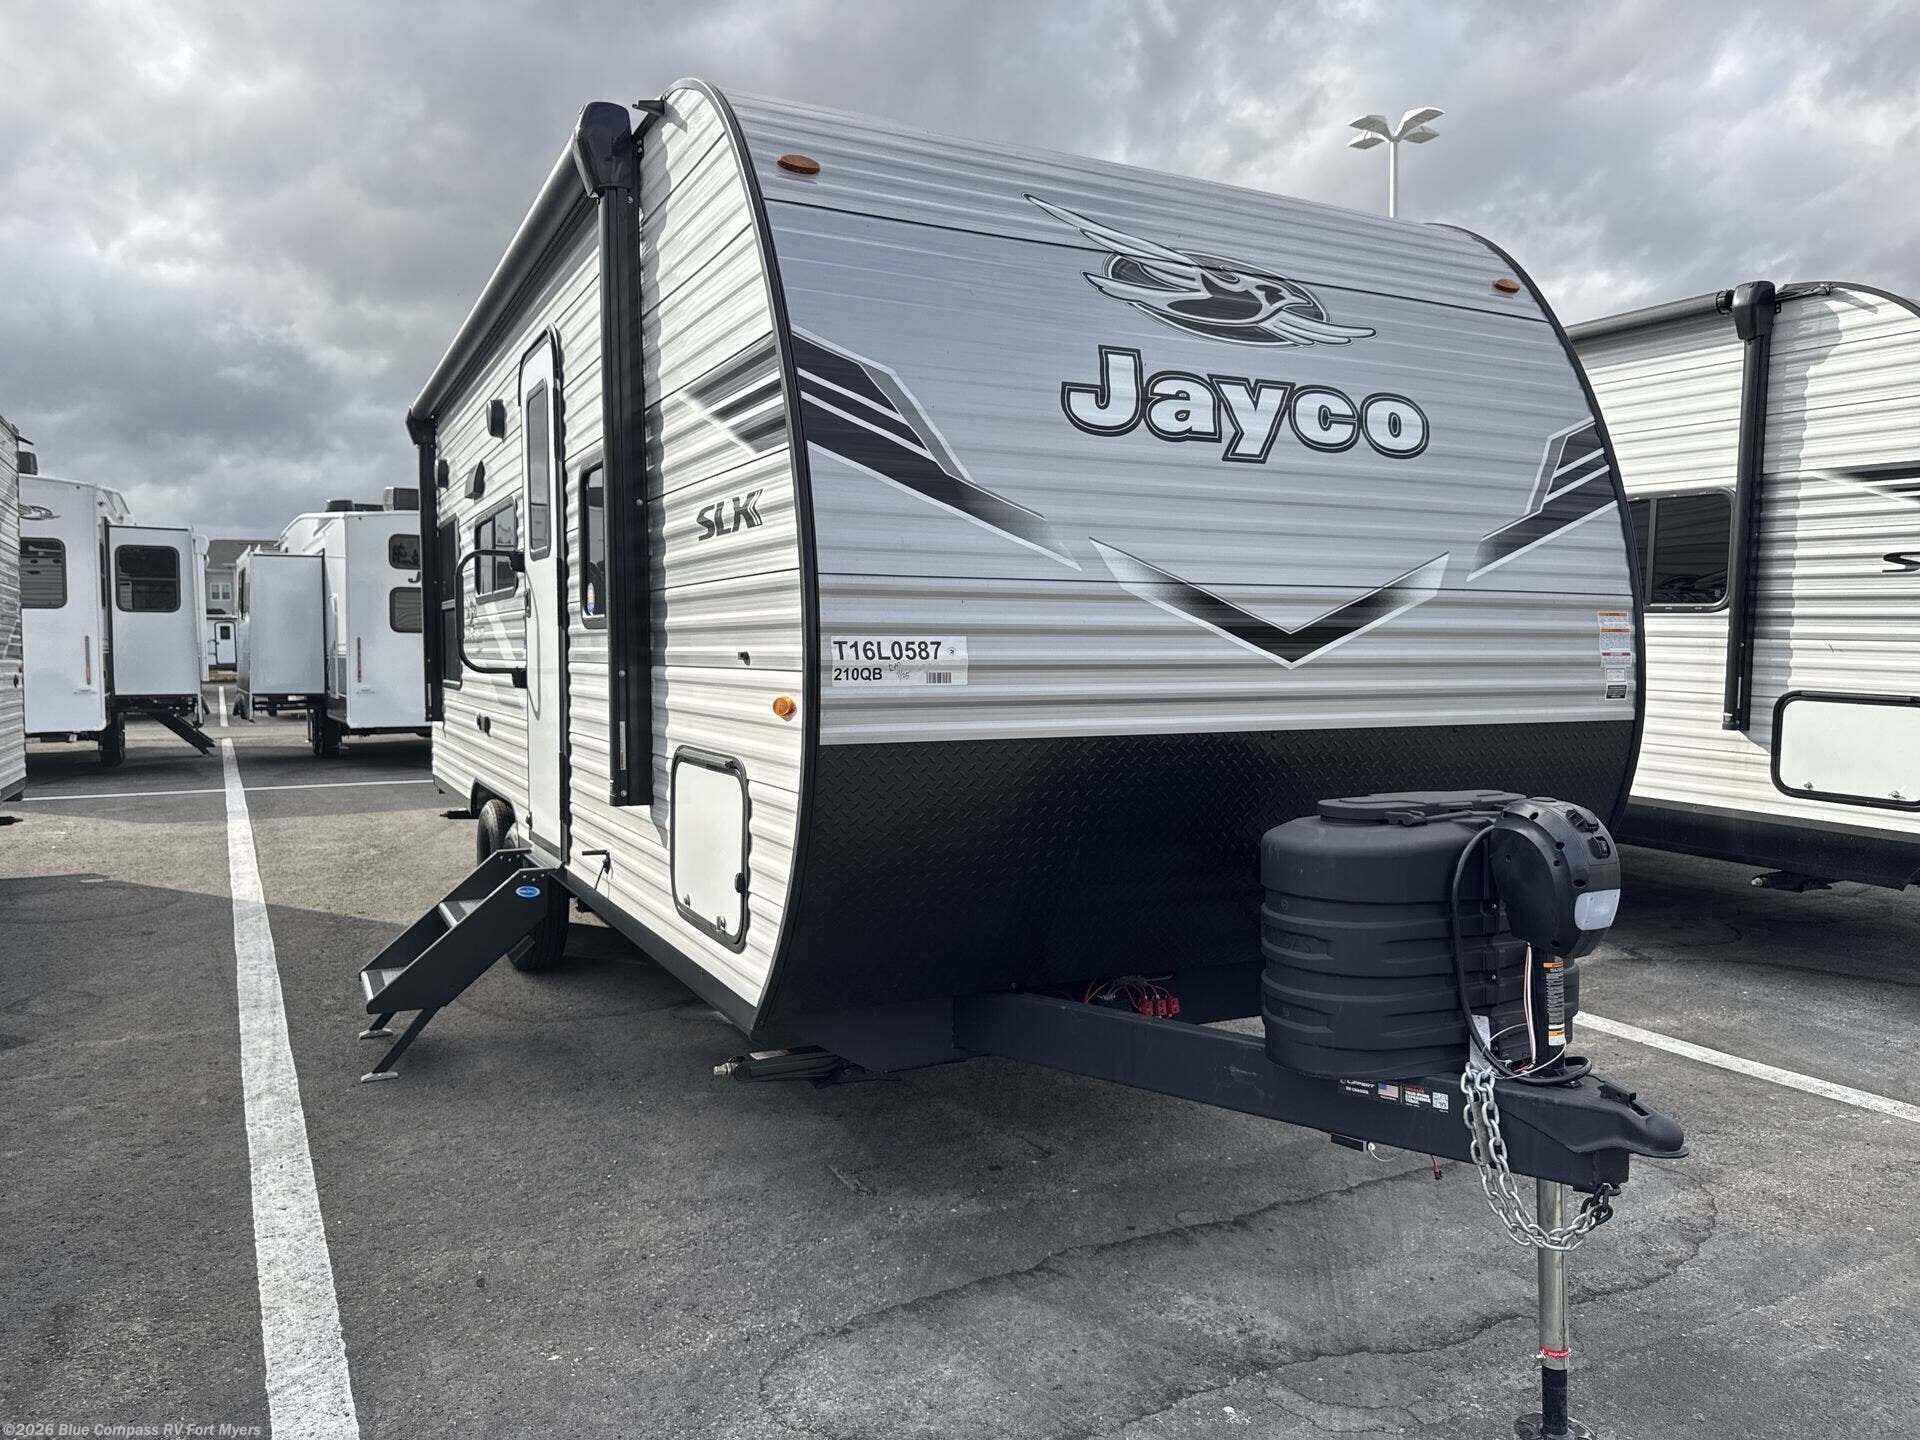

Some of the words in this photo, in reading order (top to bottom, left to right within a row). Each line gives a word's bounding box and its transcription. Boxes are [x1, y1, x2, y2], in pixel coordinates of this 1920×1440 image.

[1060, 344, 1430, 464] Jayco
[696, 488, 763, 541] SLK
[833, 641, 942, 660] T16L0587
[833, 667, 883, 681] 210QB
